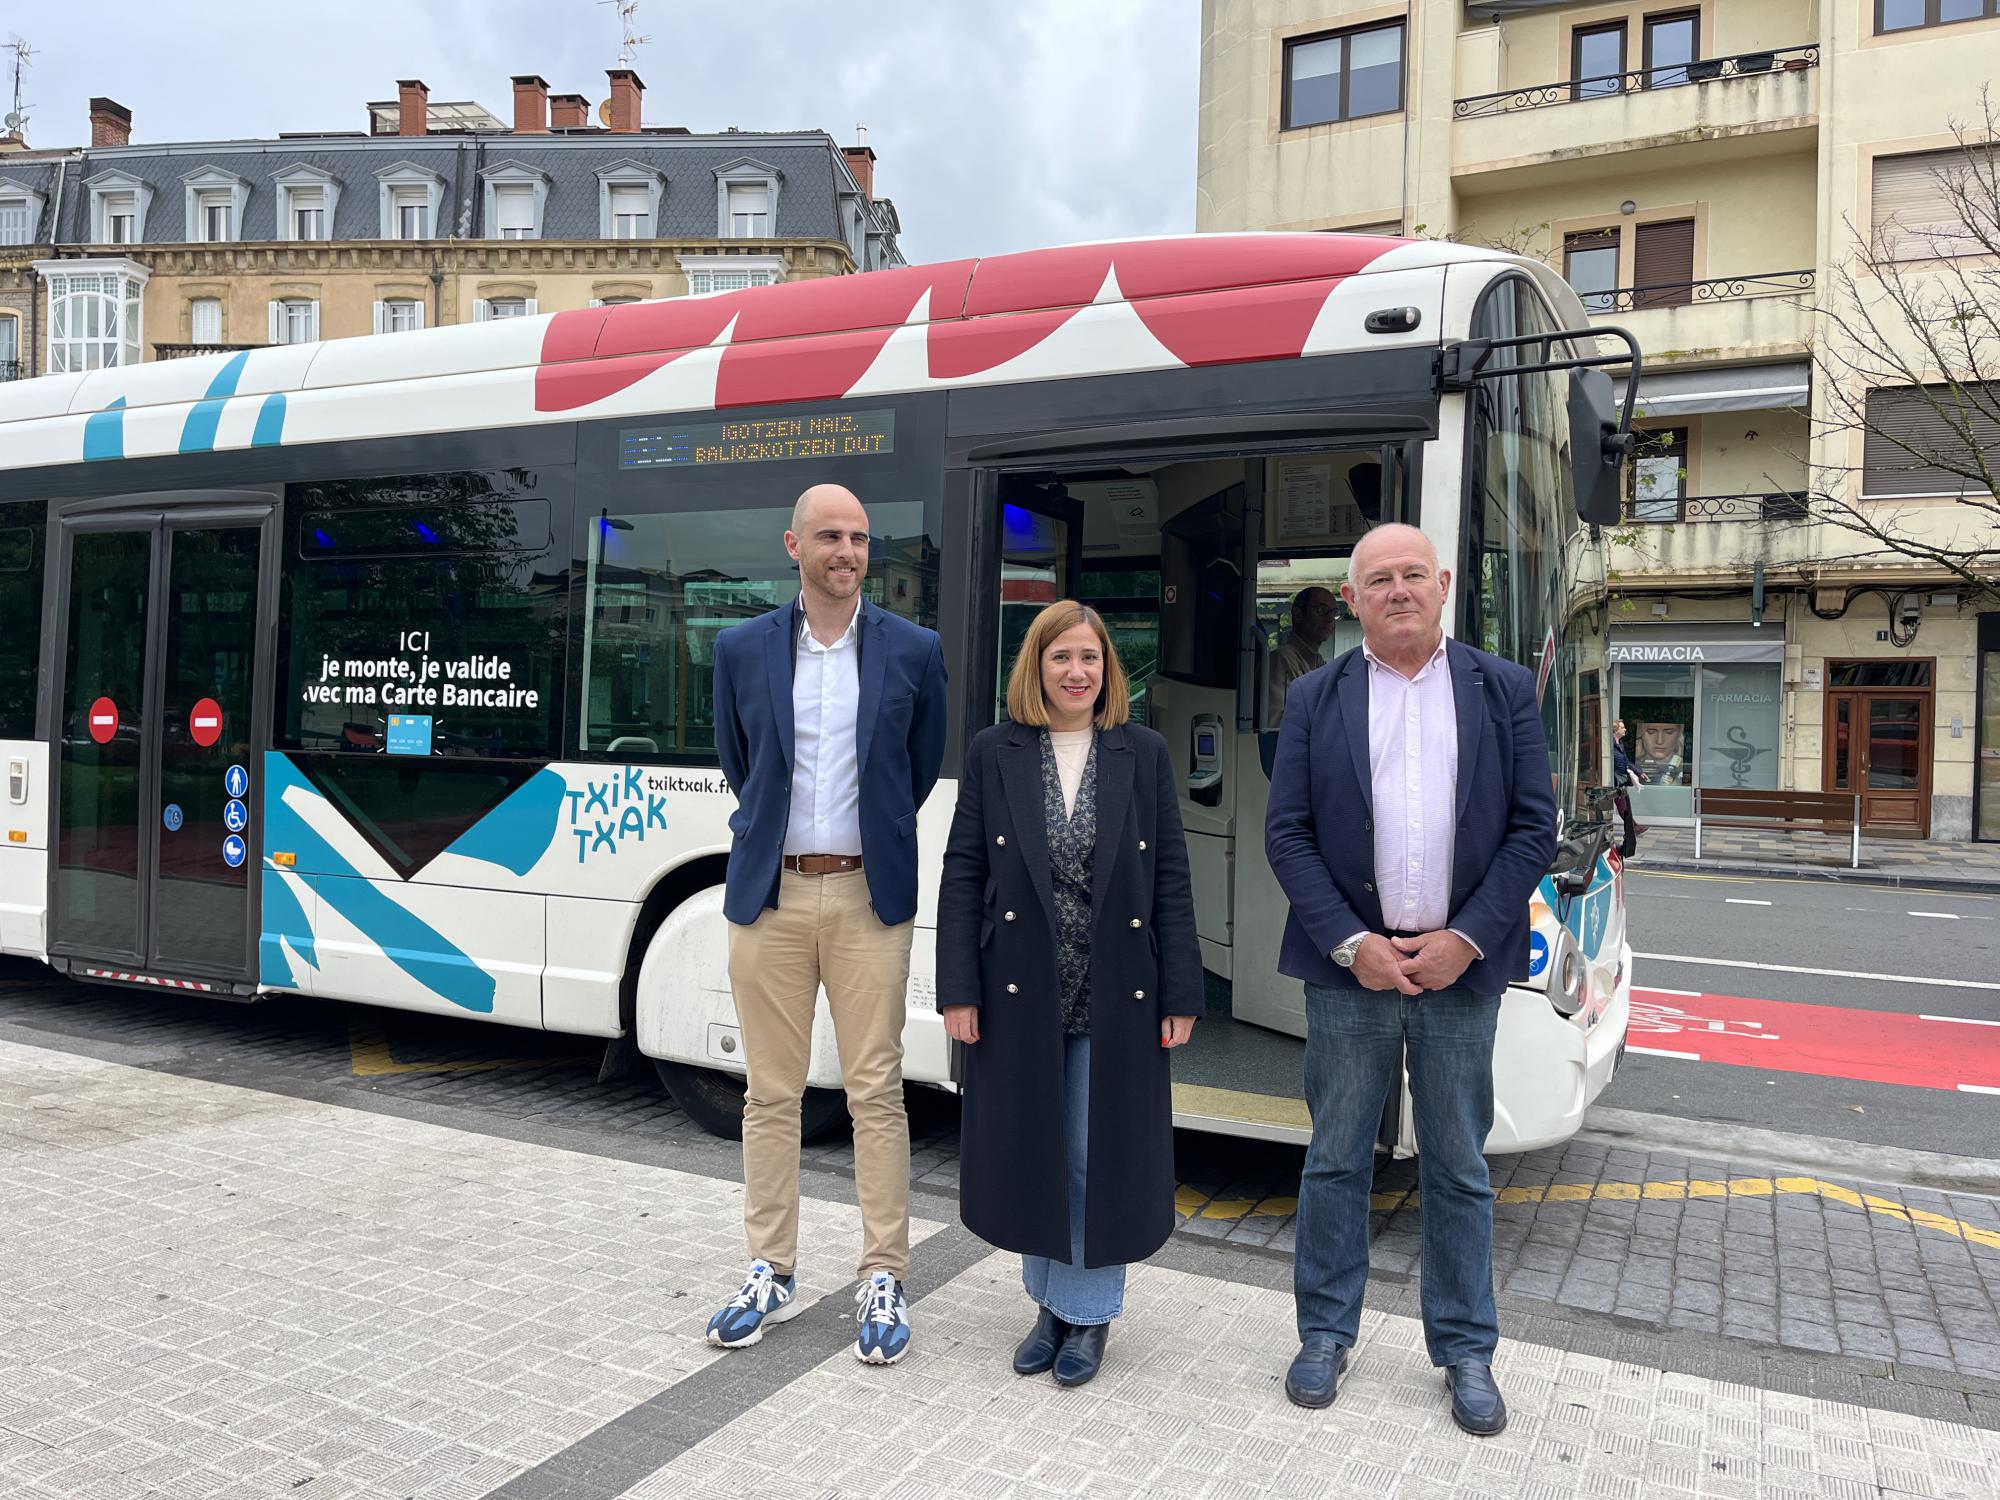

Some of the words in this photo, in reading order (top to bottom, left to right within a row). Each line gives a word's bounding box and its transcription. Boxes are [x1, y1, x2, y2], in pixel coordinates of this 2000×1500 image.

[722, 420, 801, 440] IGOTZEN
[696, 438, 836, 462] BALIOZKOTZEN
[845, 435, 884, 453] DUT
[400, 631, 430, 651] ICI
[1610, 647, 1705, 660] FARMACIA
[320, 654, 340, 682] je
[345, 657, 416, 683] monte,
[420, 655, 440, 683] je
[445, 655, 511, 680] valide
[345, 685, 376, 704] ma
[381, 683, 437, 705] Carte
[442, 683, 539, 708] Bancaire
[1711, 694, 1772, 703] FARMACIA
[573, 794, 667, 864] TXAK
